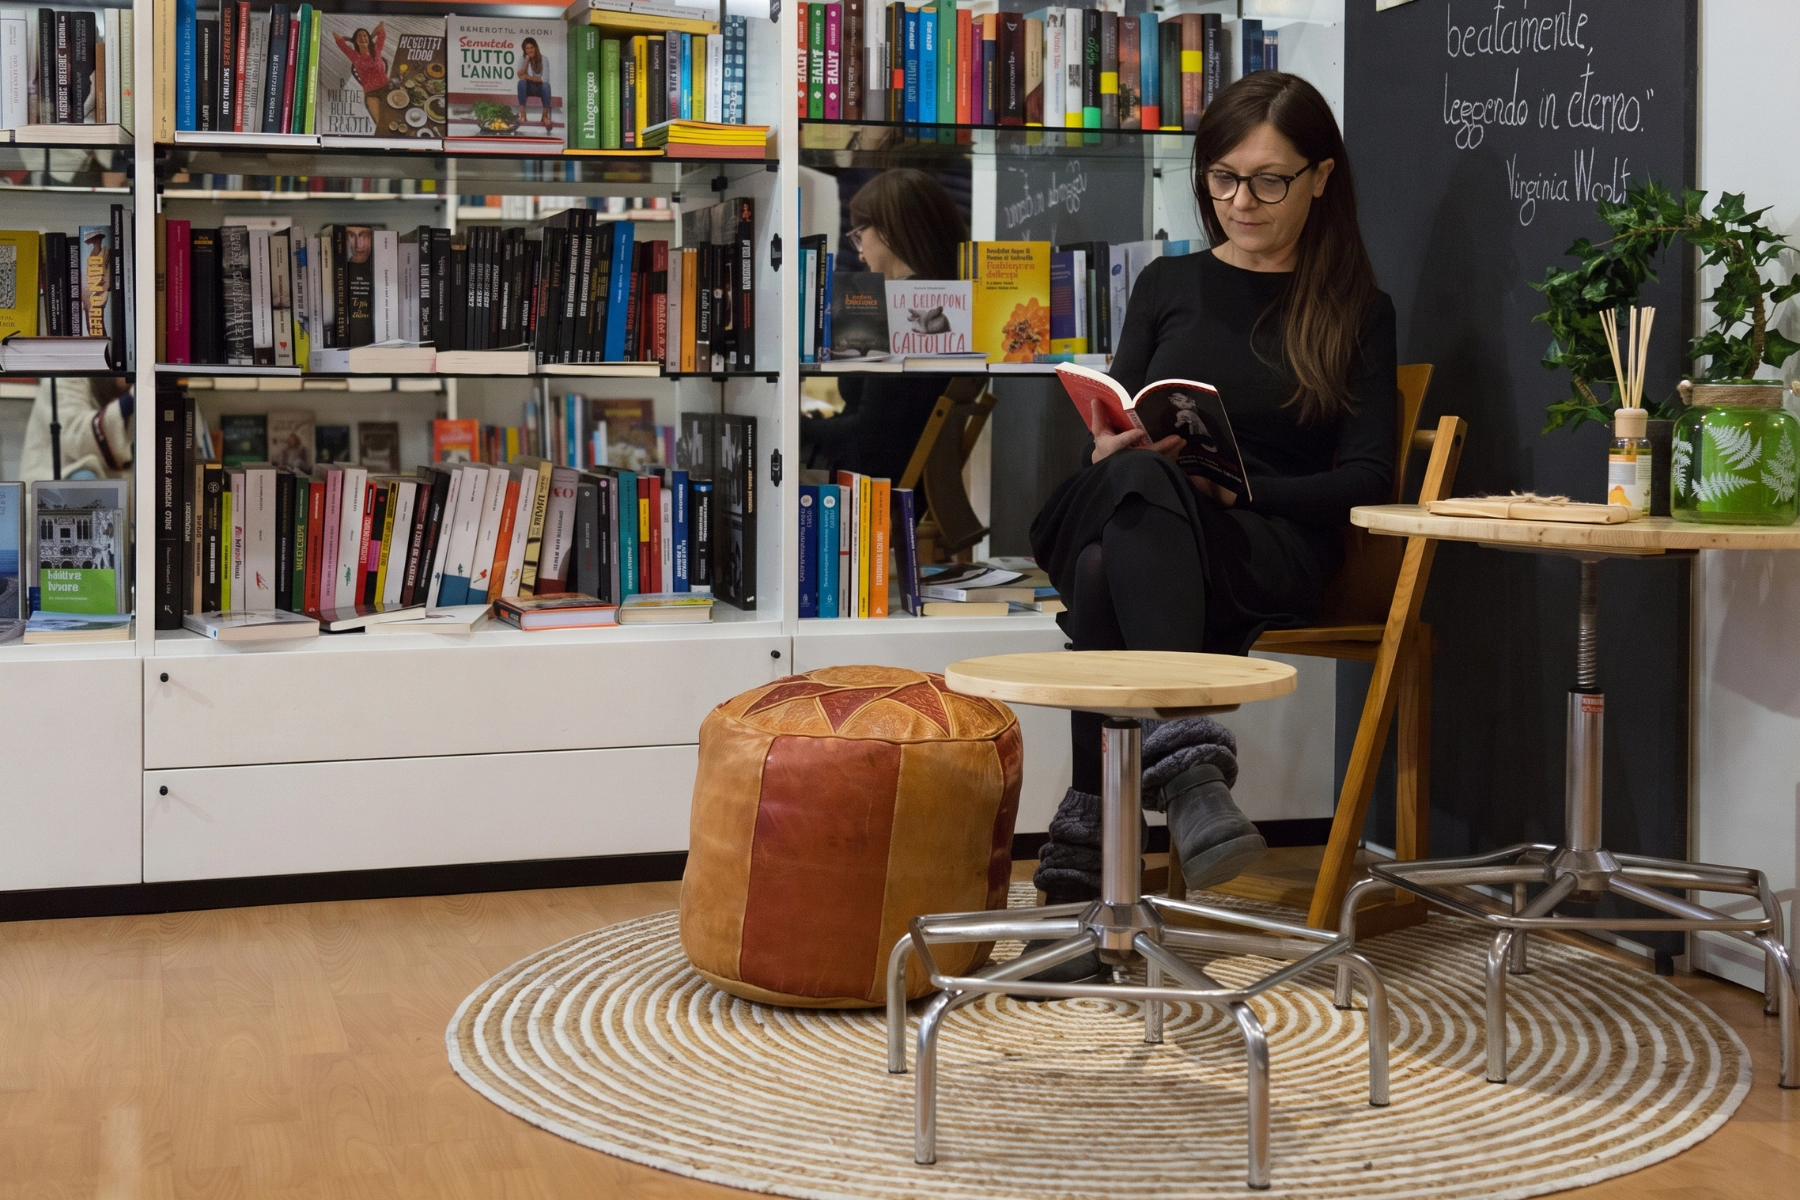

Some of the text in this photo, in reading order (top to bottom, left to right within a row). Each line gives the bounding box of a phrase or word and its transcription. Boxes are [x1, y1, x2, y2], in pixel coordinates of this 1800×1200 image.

[460, 48, 515, 65] TUTTO
[461, 64, 515, 80] L'ANNO
[1443, 68, 1528, 149] leggendo
[1538, 88, 1560, 130] in
[1506, 153, 1569, 226] Virginia
[893, 293, 906, 309] LA
